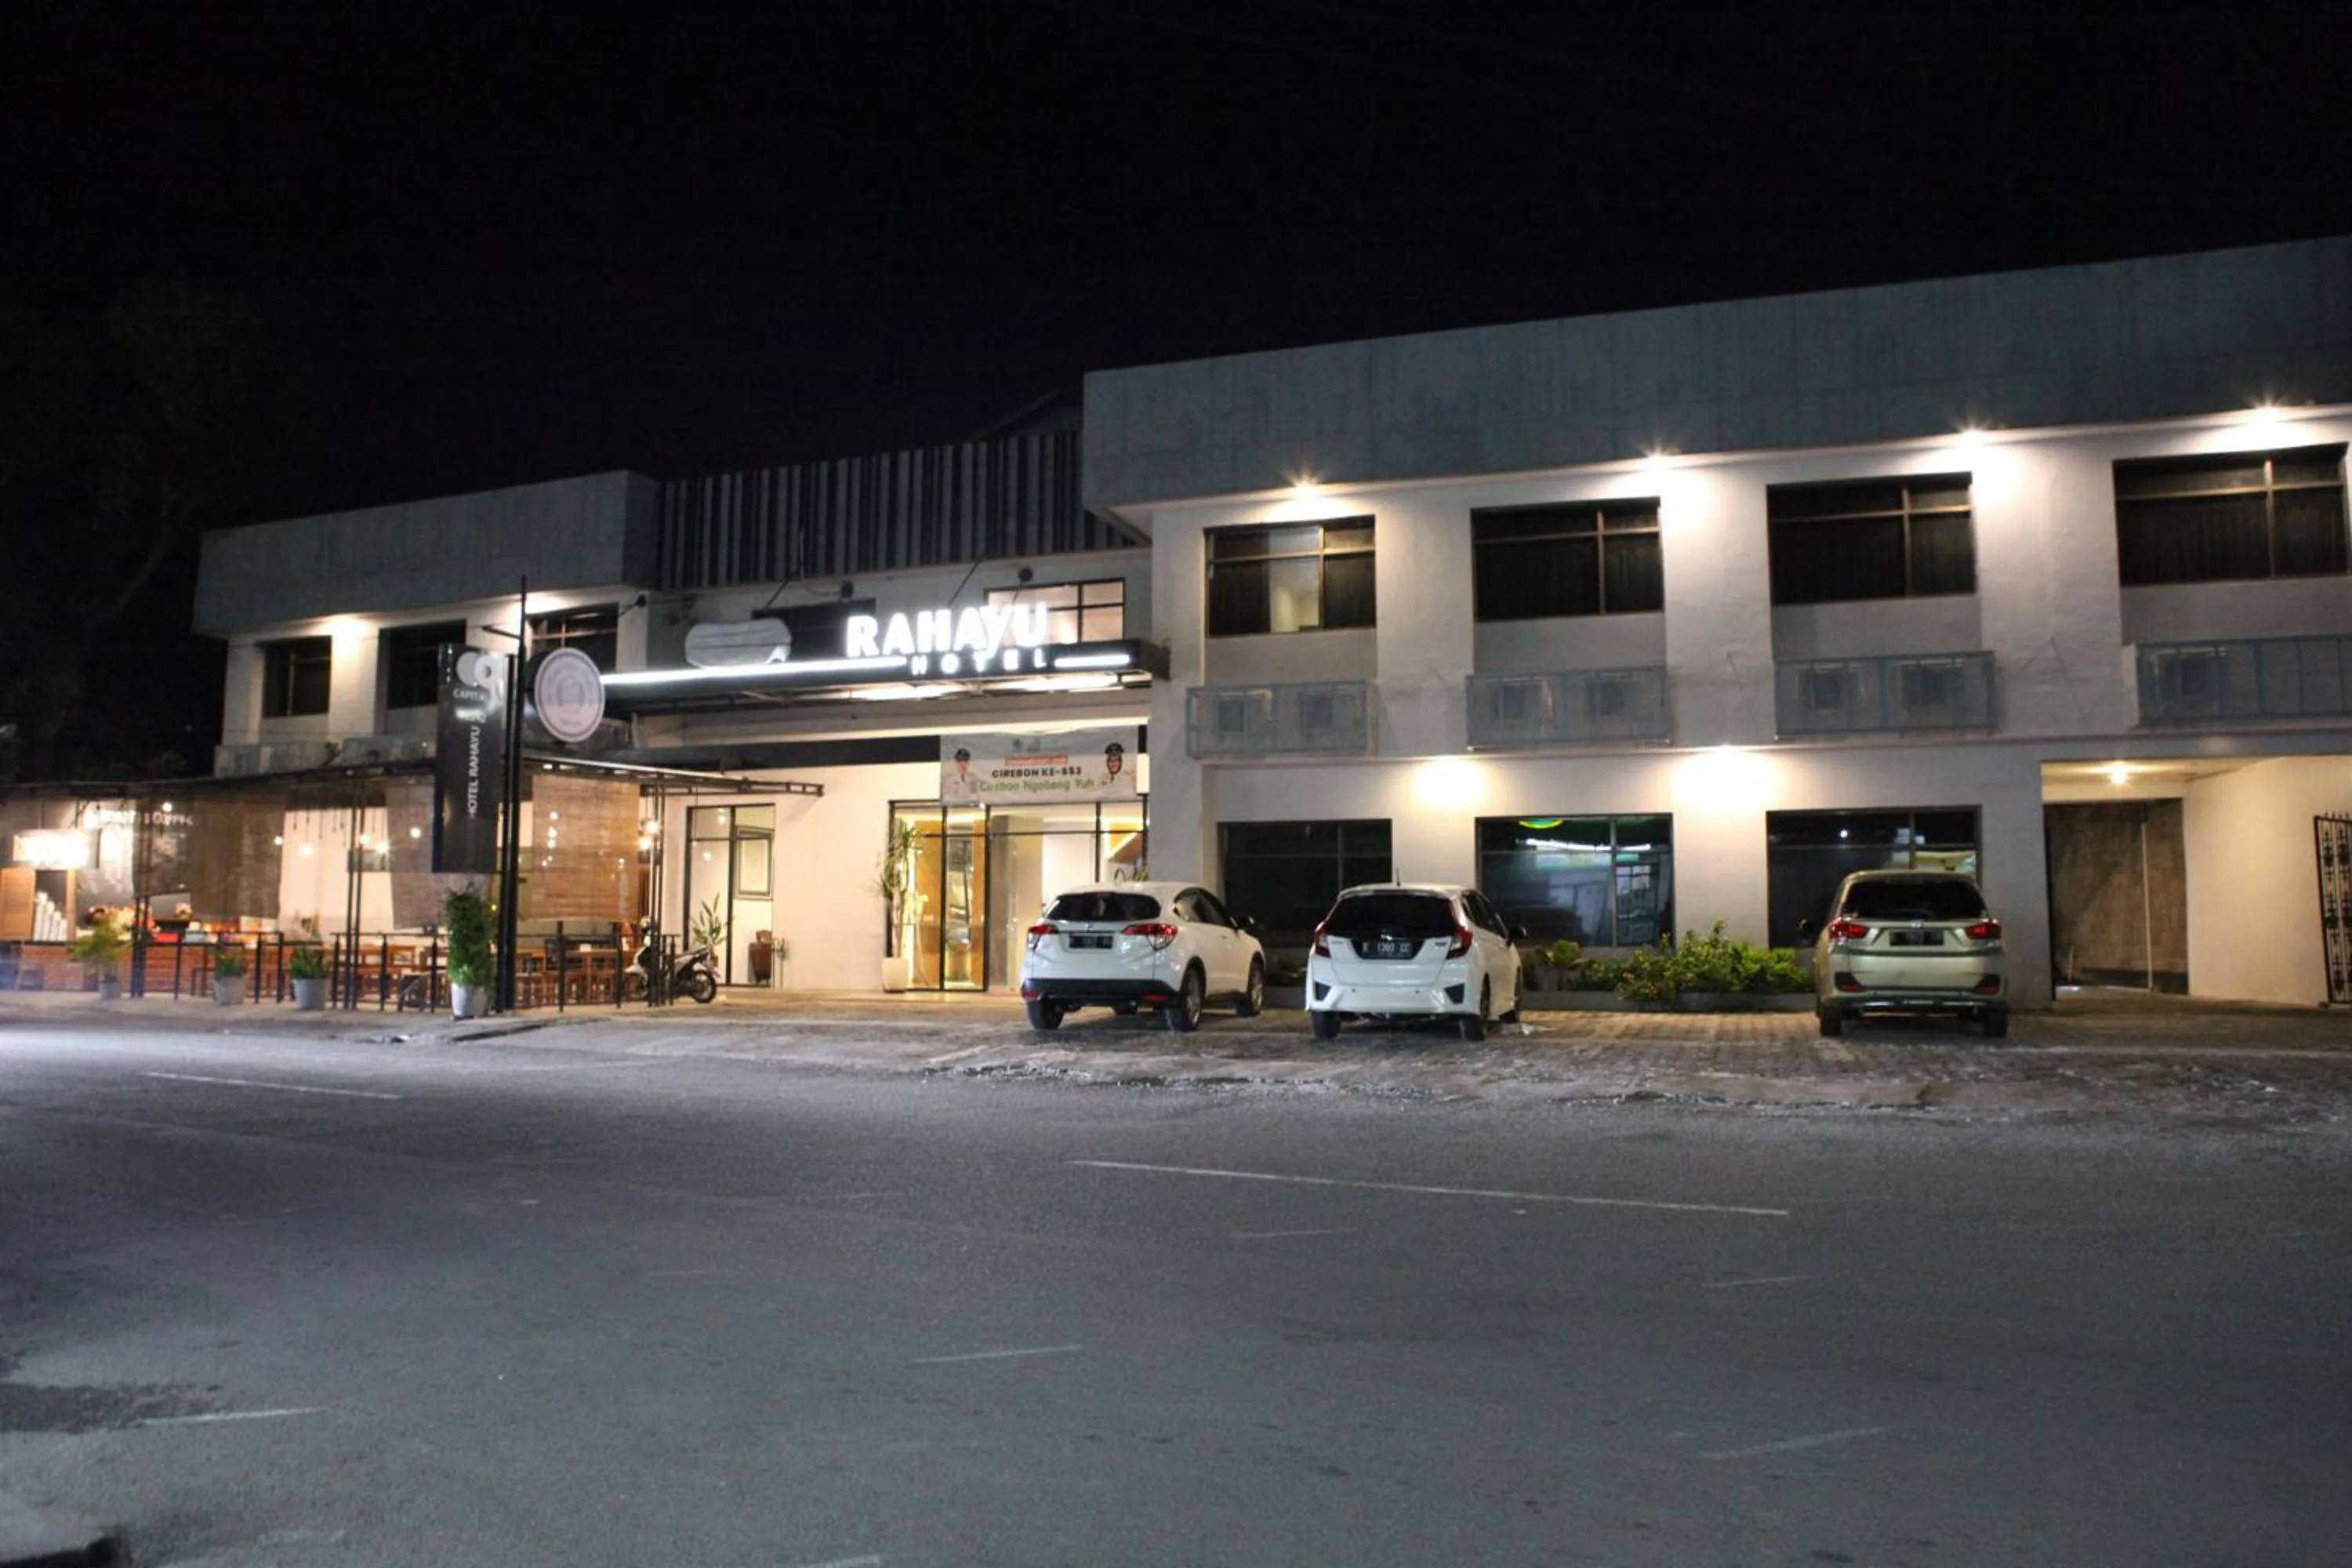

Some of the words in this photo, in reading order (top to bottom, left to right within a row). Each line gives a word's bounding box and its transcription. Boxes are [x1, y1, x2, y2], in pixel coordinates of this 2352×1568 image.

[847, 601, 1047, 659] RAHAYU
[911, 648, 1047, 675] HOTEL
[469, 725, 481, 777] RAHAYU
[467, 779, 479, 818] HOTEL
